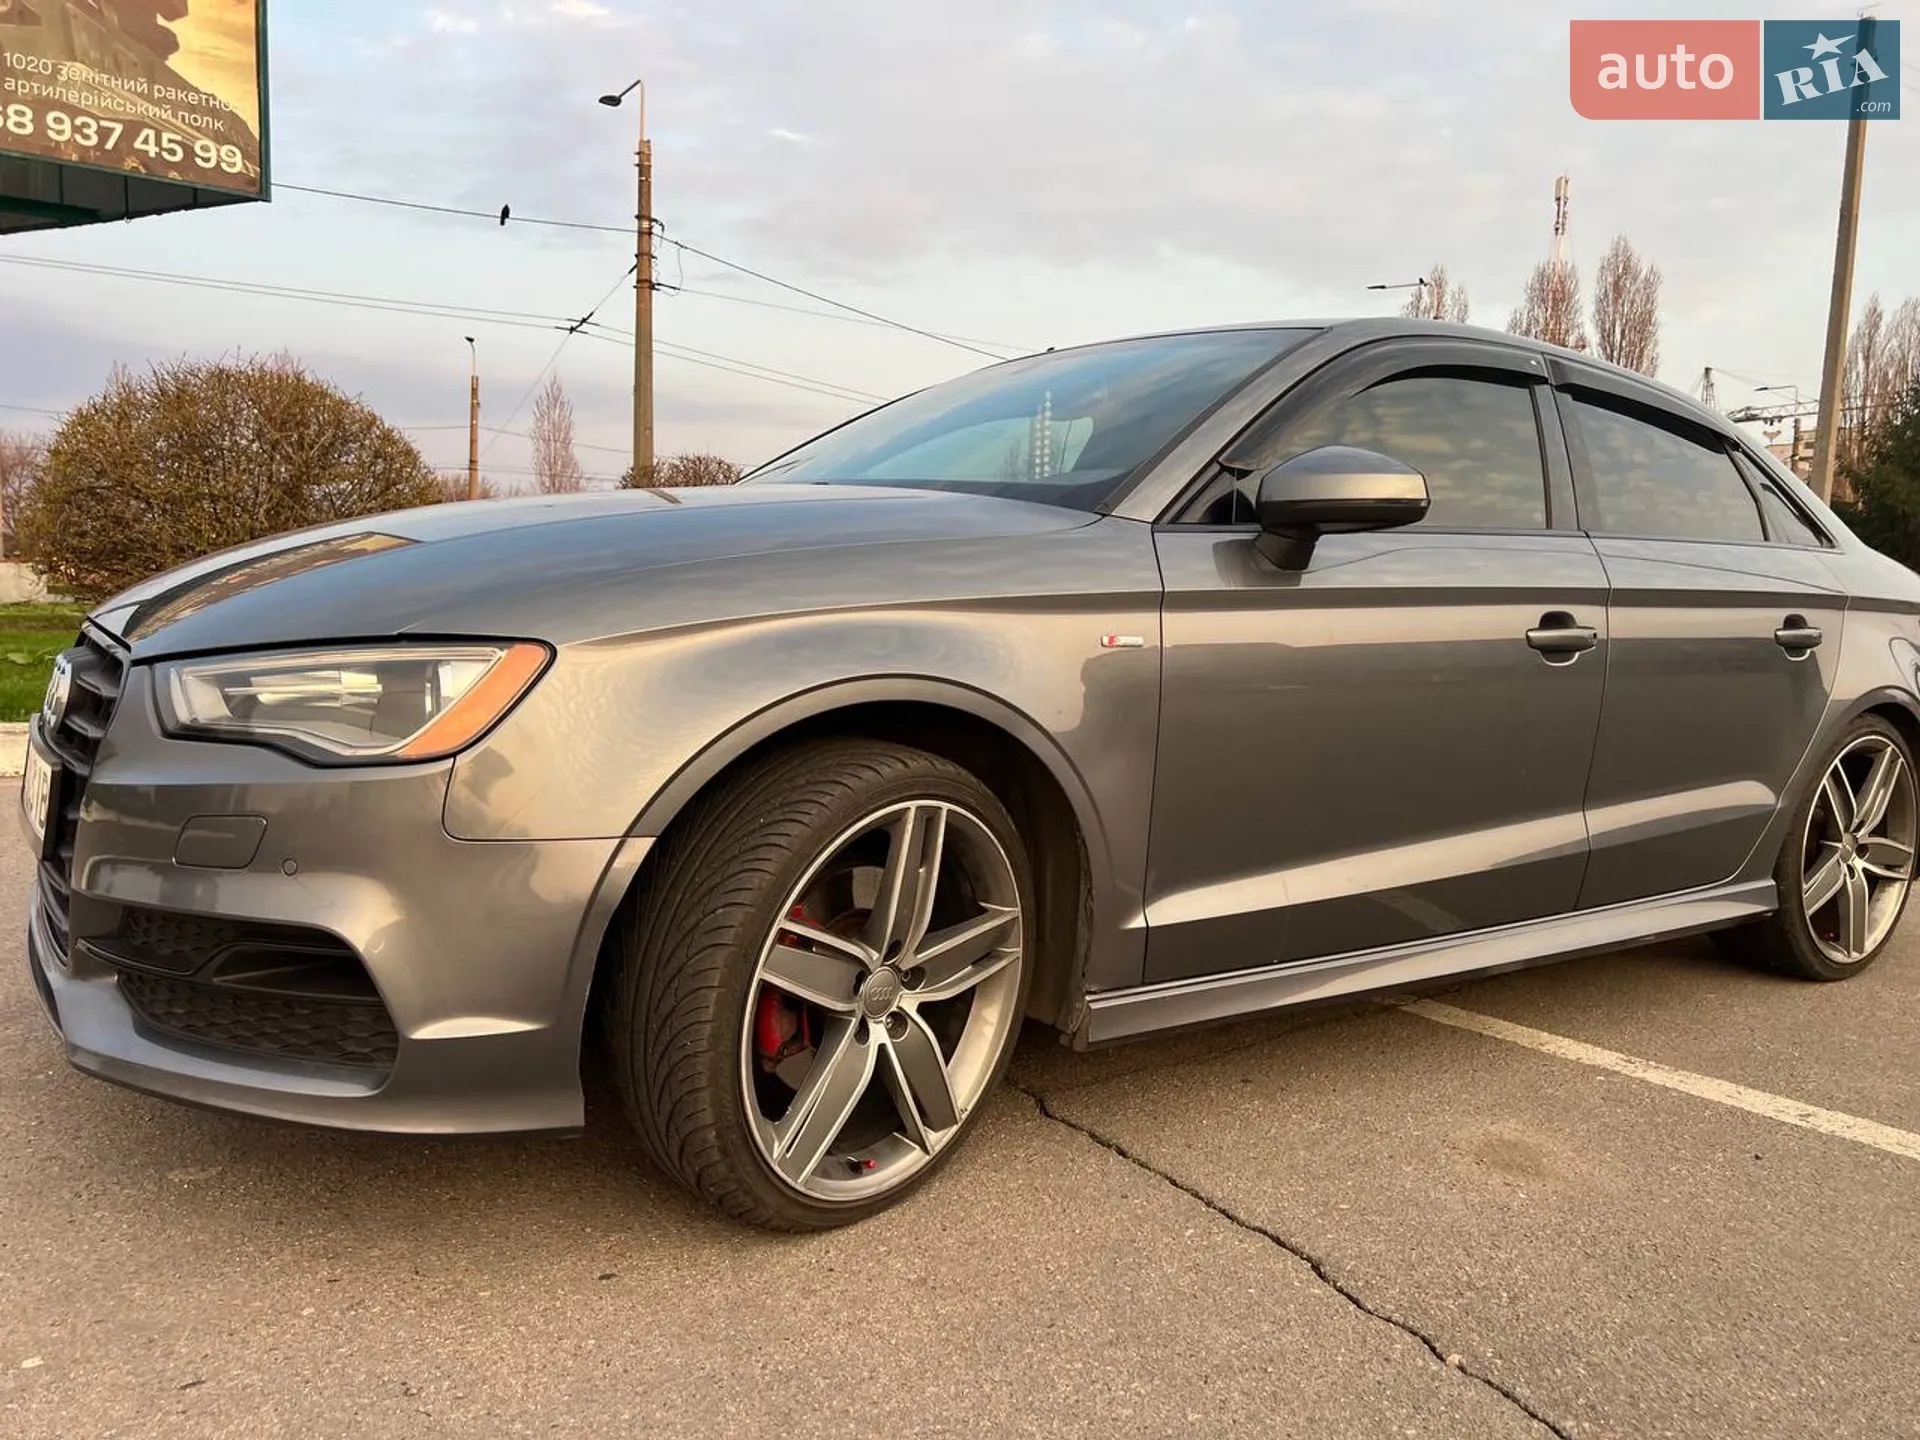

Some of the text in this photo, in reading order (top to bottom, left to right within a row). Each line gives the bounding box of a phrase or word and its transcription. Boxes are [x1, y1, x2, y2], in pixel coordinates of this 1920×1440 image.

[3, 52, 53, 75] 1020
[4, 77, 225, 132] артилерійський полк
[0, 103, 243, 174] 8 937 45 99
